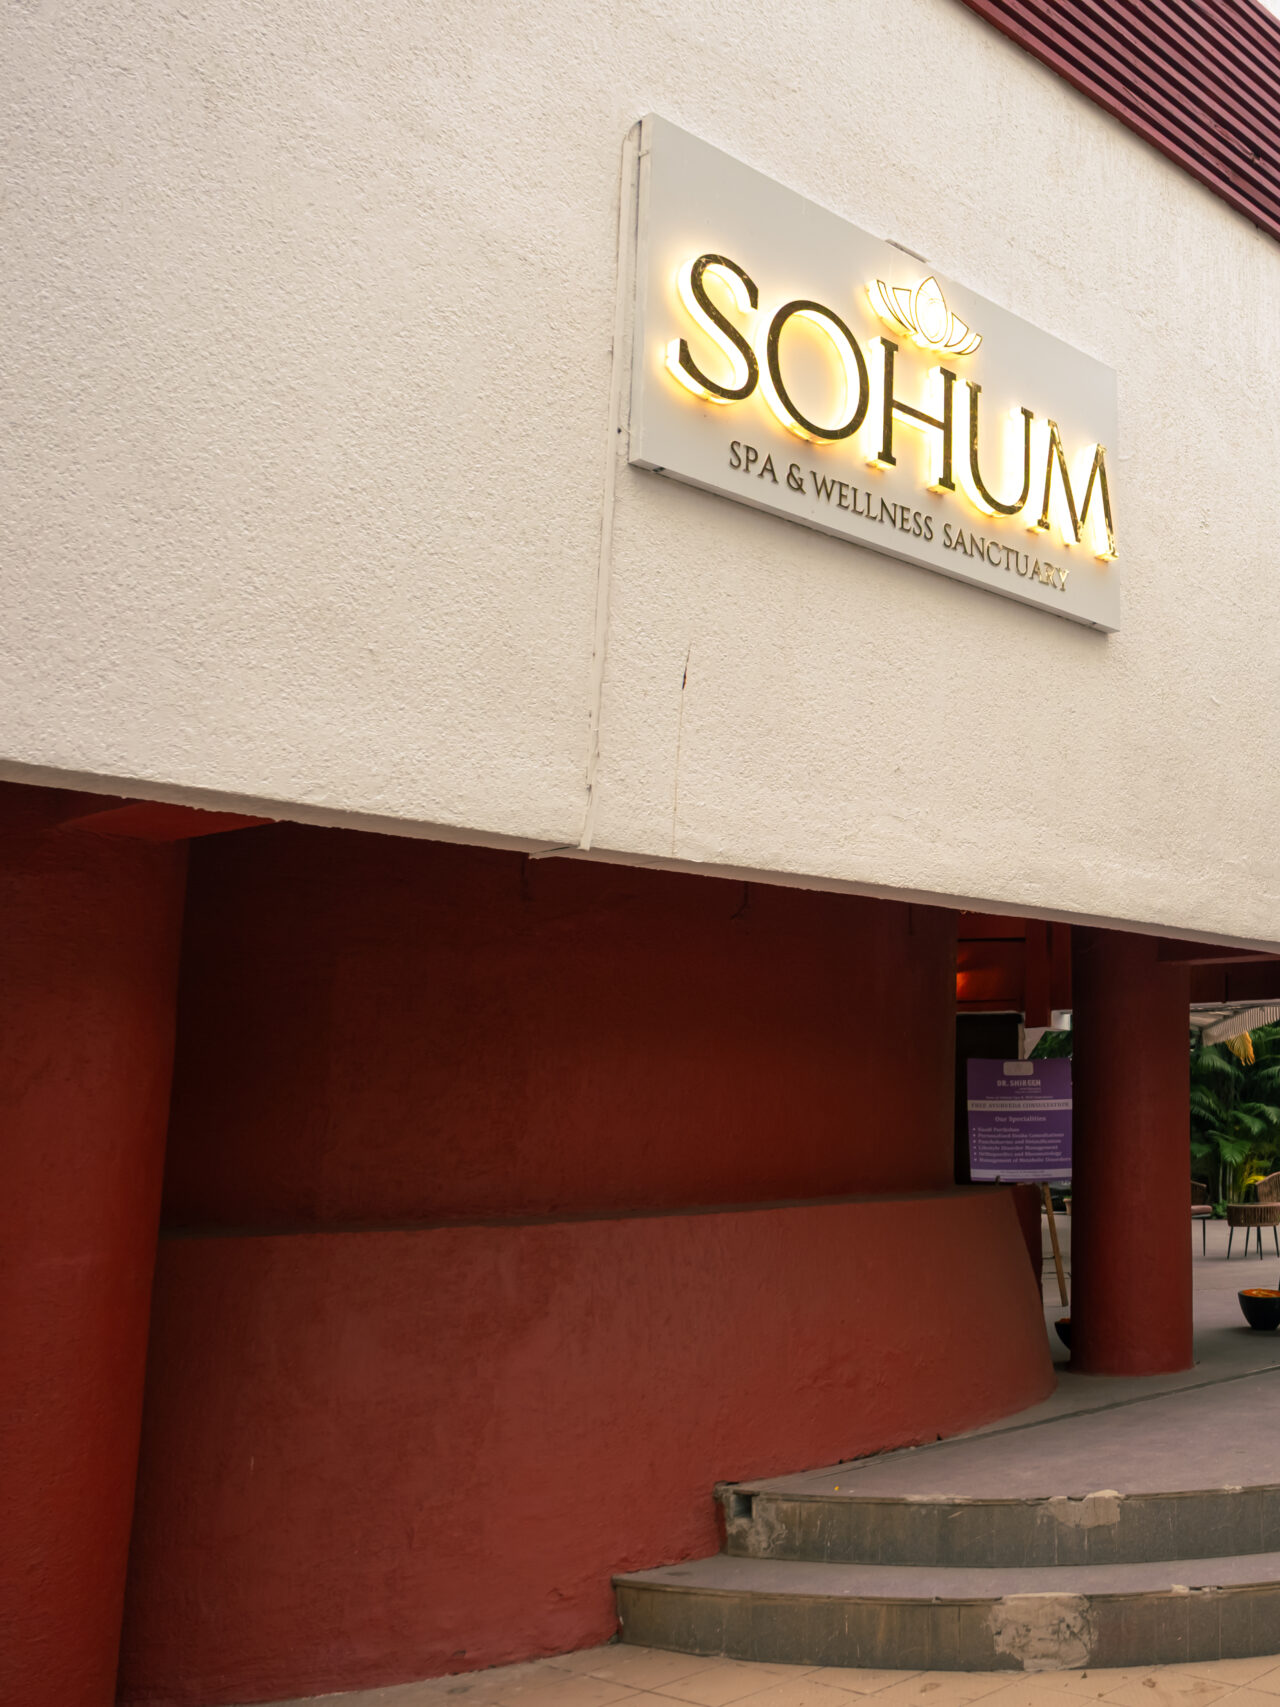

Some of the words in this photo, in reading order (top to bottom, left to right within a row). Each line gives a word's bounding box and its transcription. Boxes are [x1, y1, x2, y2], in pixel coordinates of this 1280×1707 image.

[674, 252, 1119, 559] SOHUM
[729, 440, 777, 484] SPA
[786, 463, 805, 495] &
[810, 470, 935, 543] WELLNESS
[942, 523, 1070, 592] SANCTUARY
